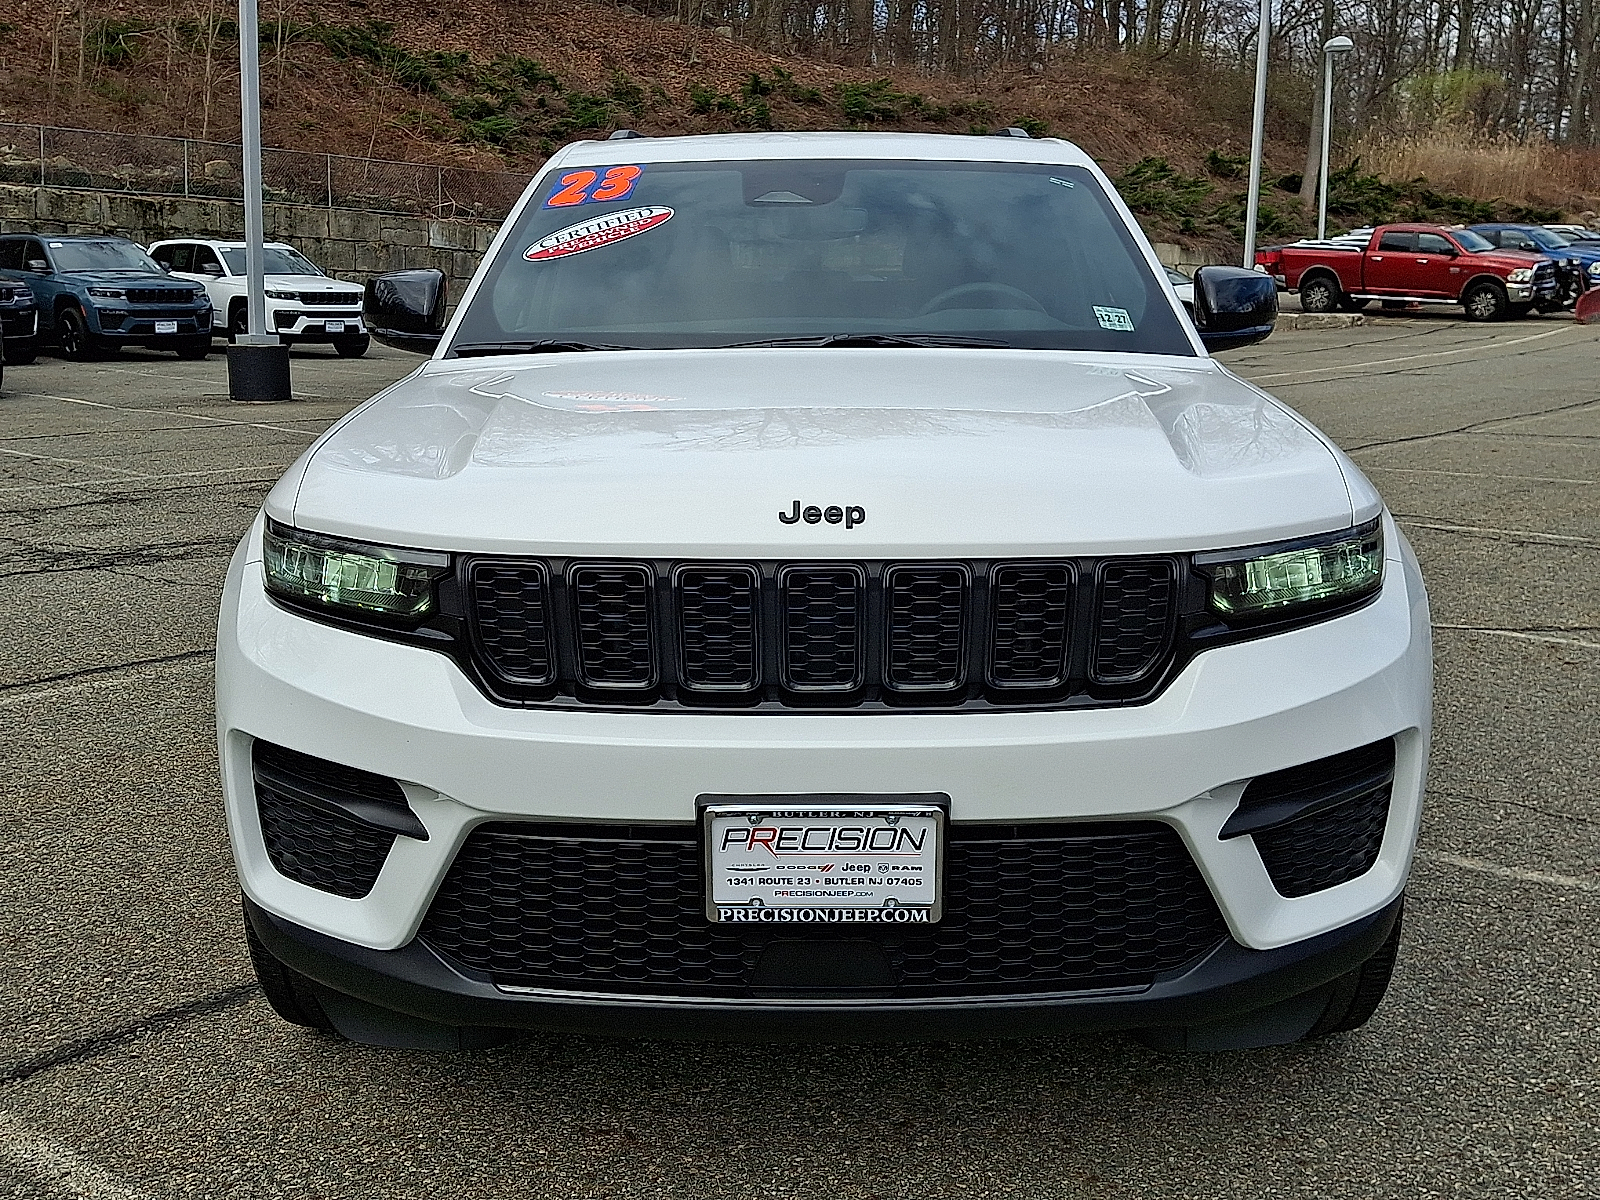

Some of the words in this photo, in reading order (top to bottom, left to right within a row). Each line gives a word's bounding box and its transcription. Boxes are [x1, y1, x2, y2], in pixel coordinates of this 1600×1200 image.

[547, 165, 642, 207] 23
[539, 207, 654, 249] CERTIFIED
[566, 225, 641, 252] VEHICLE
[779, 500, 866, 530] Jeep
[720, 827, 928, 858] PRECISION
[726, 877, 755, 886] 1341
[758, 877, 794, 886] ROUTE
[797, 877, 811, 886] 23
[824, 877, 865, 886] BUTLER
[868, 877, 883, 886] NJ
[886, 877, 923, 886] 07405
[841, 862, 872, 873] Jeep
[718, 908, 929, 923] PRECISIONJEEP.COM
